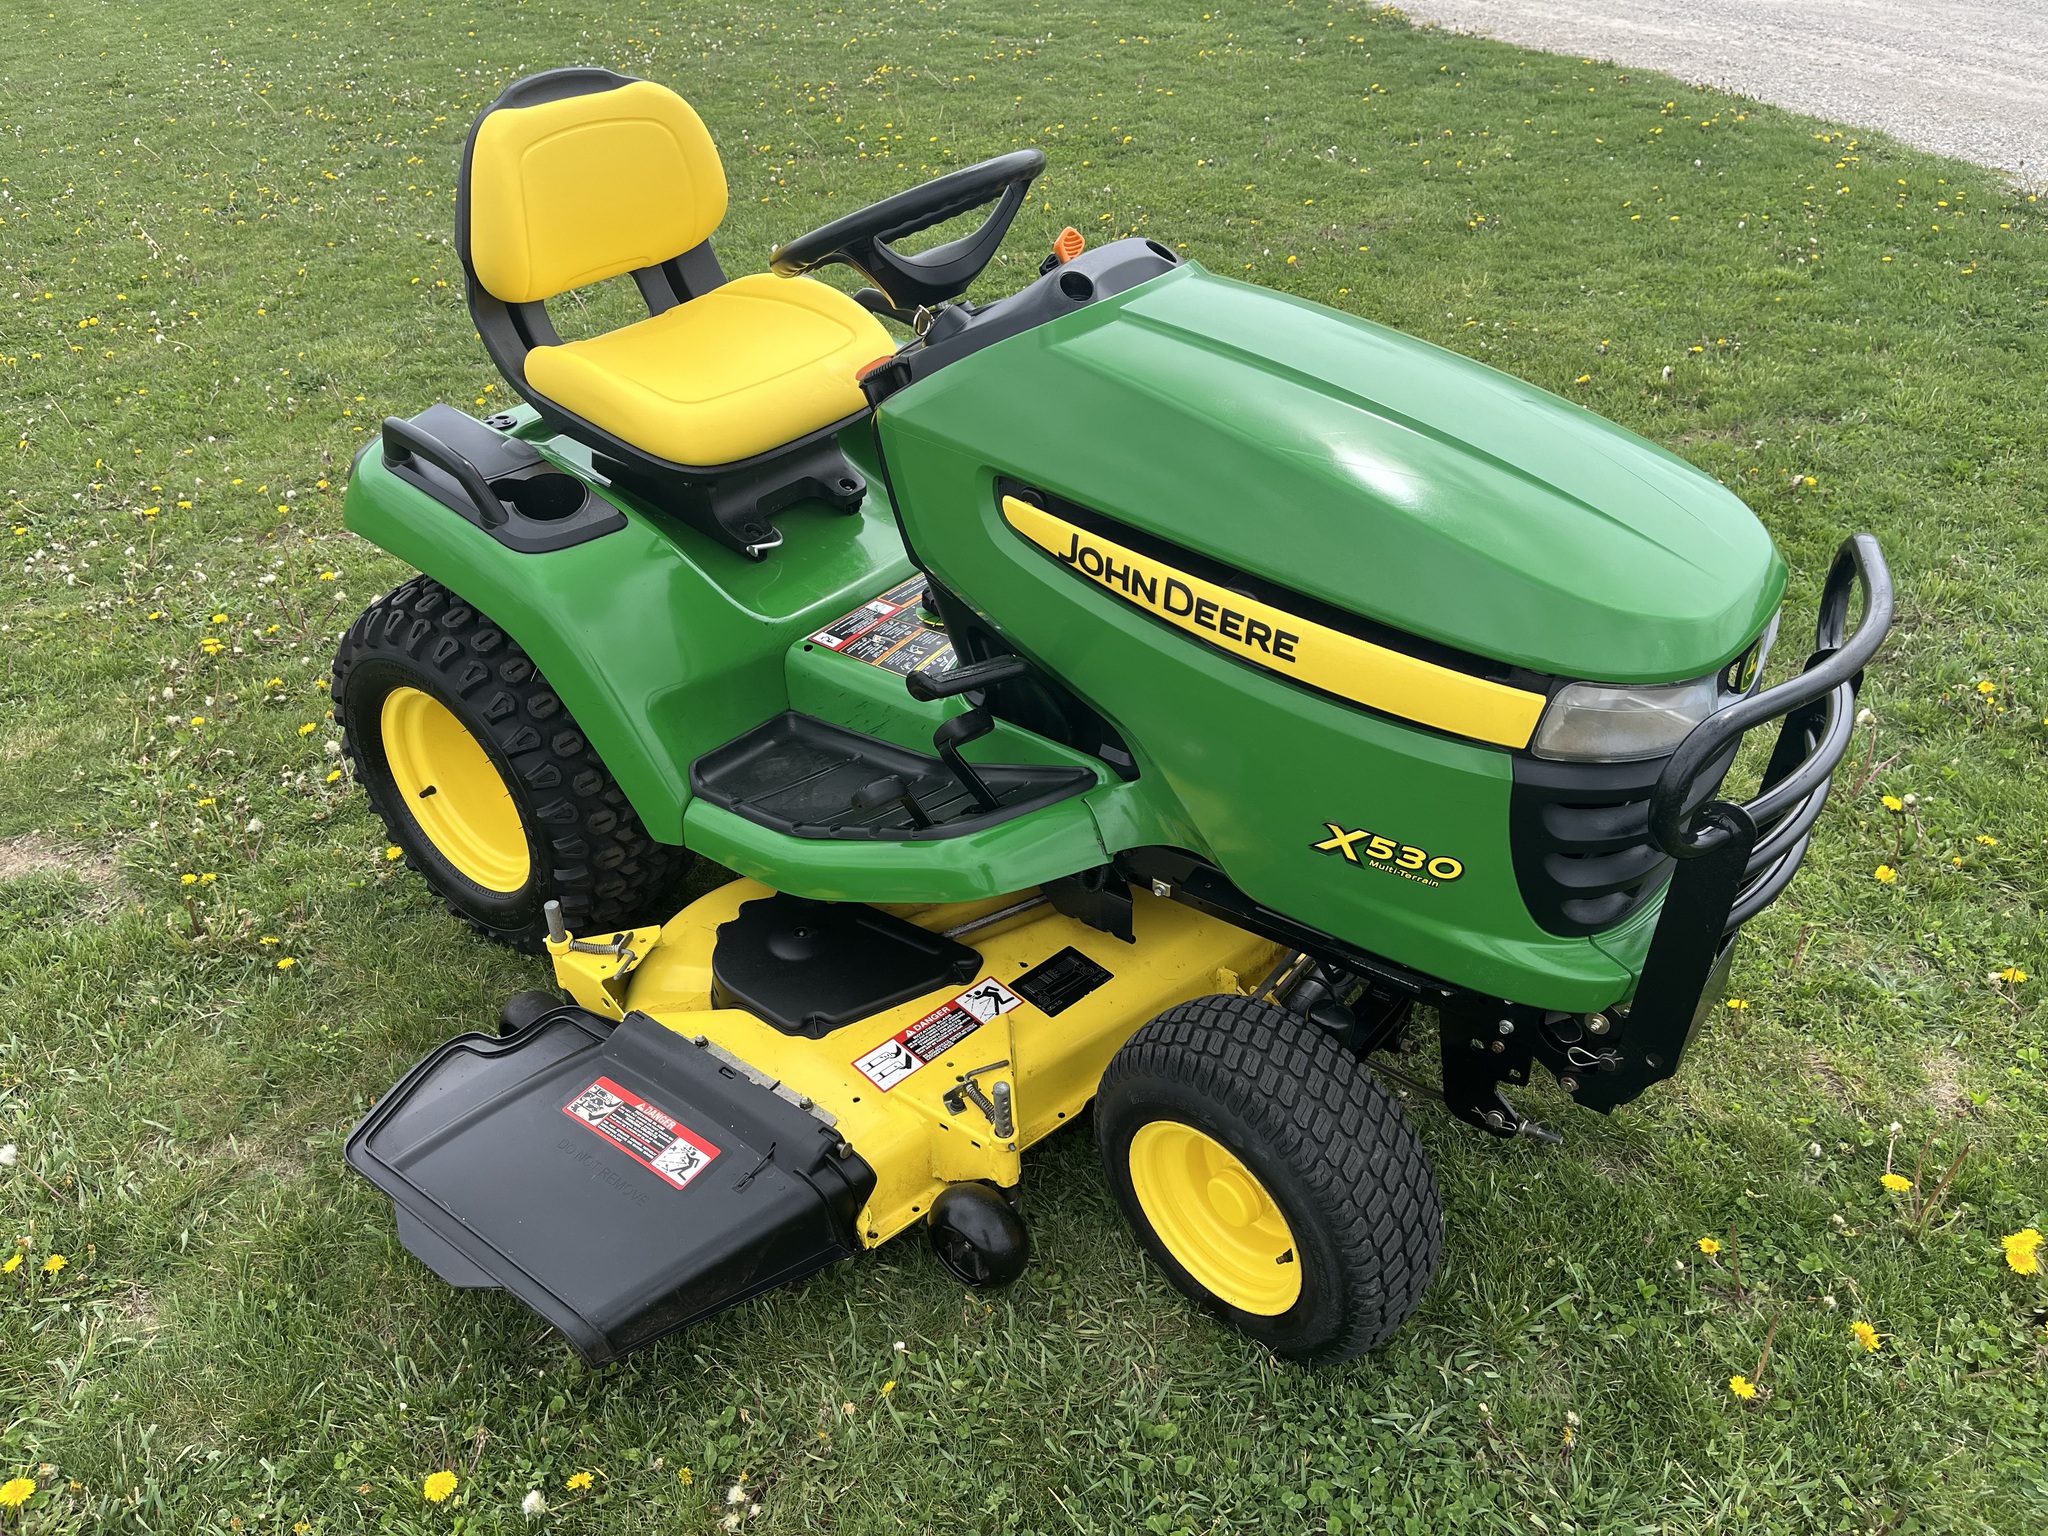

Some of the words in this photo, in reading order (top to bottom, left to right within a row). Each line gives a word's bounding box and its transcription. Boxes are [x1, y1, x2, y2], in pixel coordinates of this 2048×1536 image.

[1058, 533, 1158, 605] JOHN
[1163, 577, 1300, 663] DEERE
[1308, 822, 1465, 882] X530
[1368, 859, 1440, 888] Multi-Terrain
[912, 1006, 951, 1031] DANGER
[644, 1104, 677, 1130] DANGER
[557, 1138, 577, 1155] DO
[574, 1149, 603, 1171] NOT
[598, 1166, 650, 1207] REMOVE
